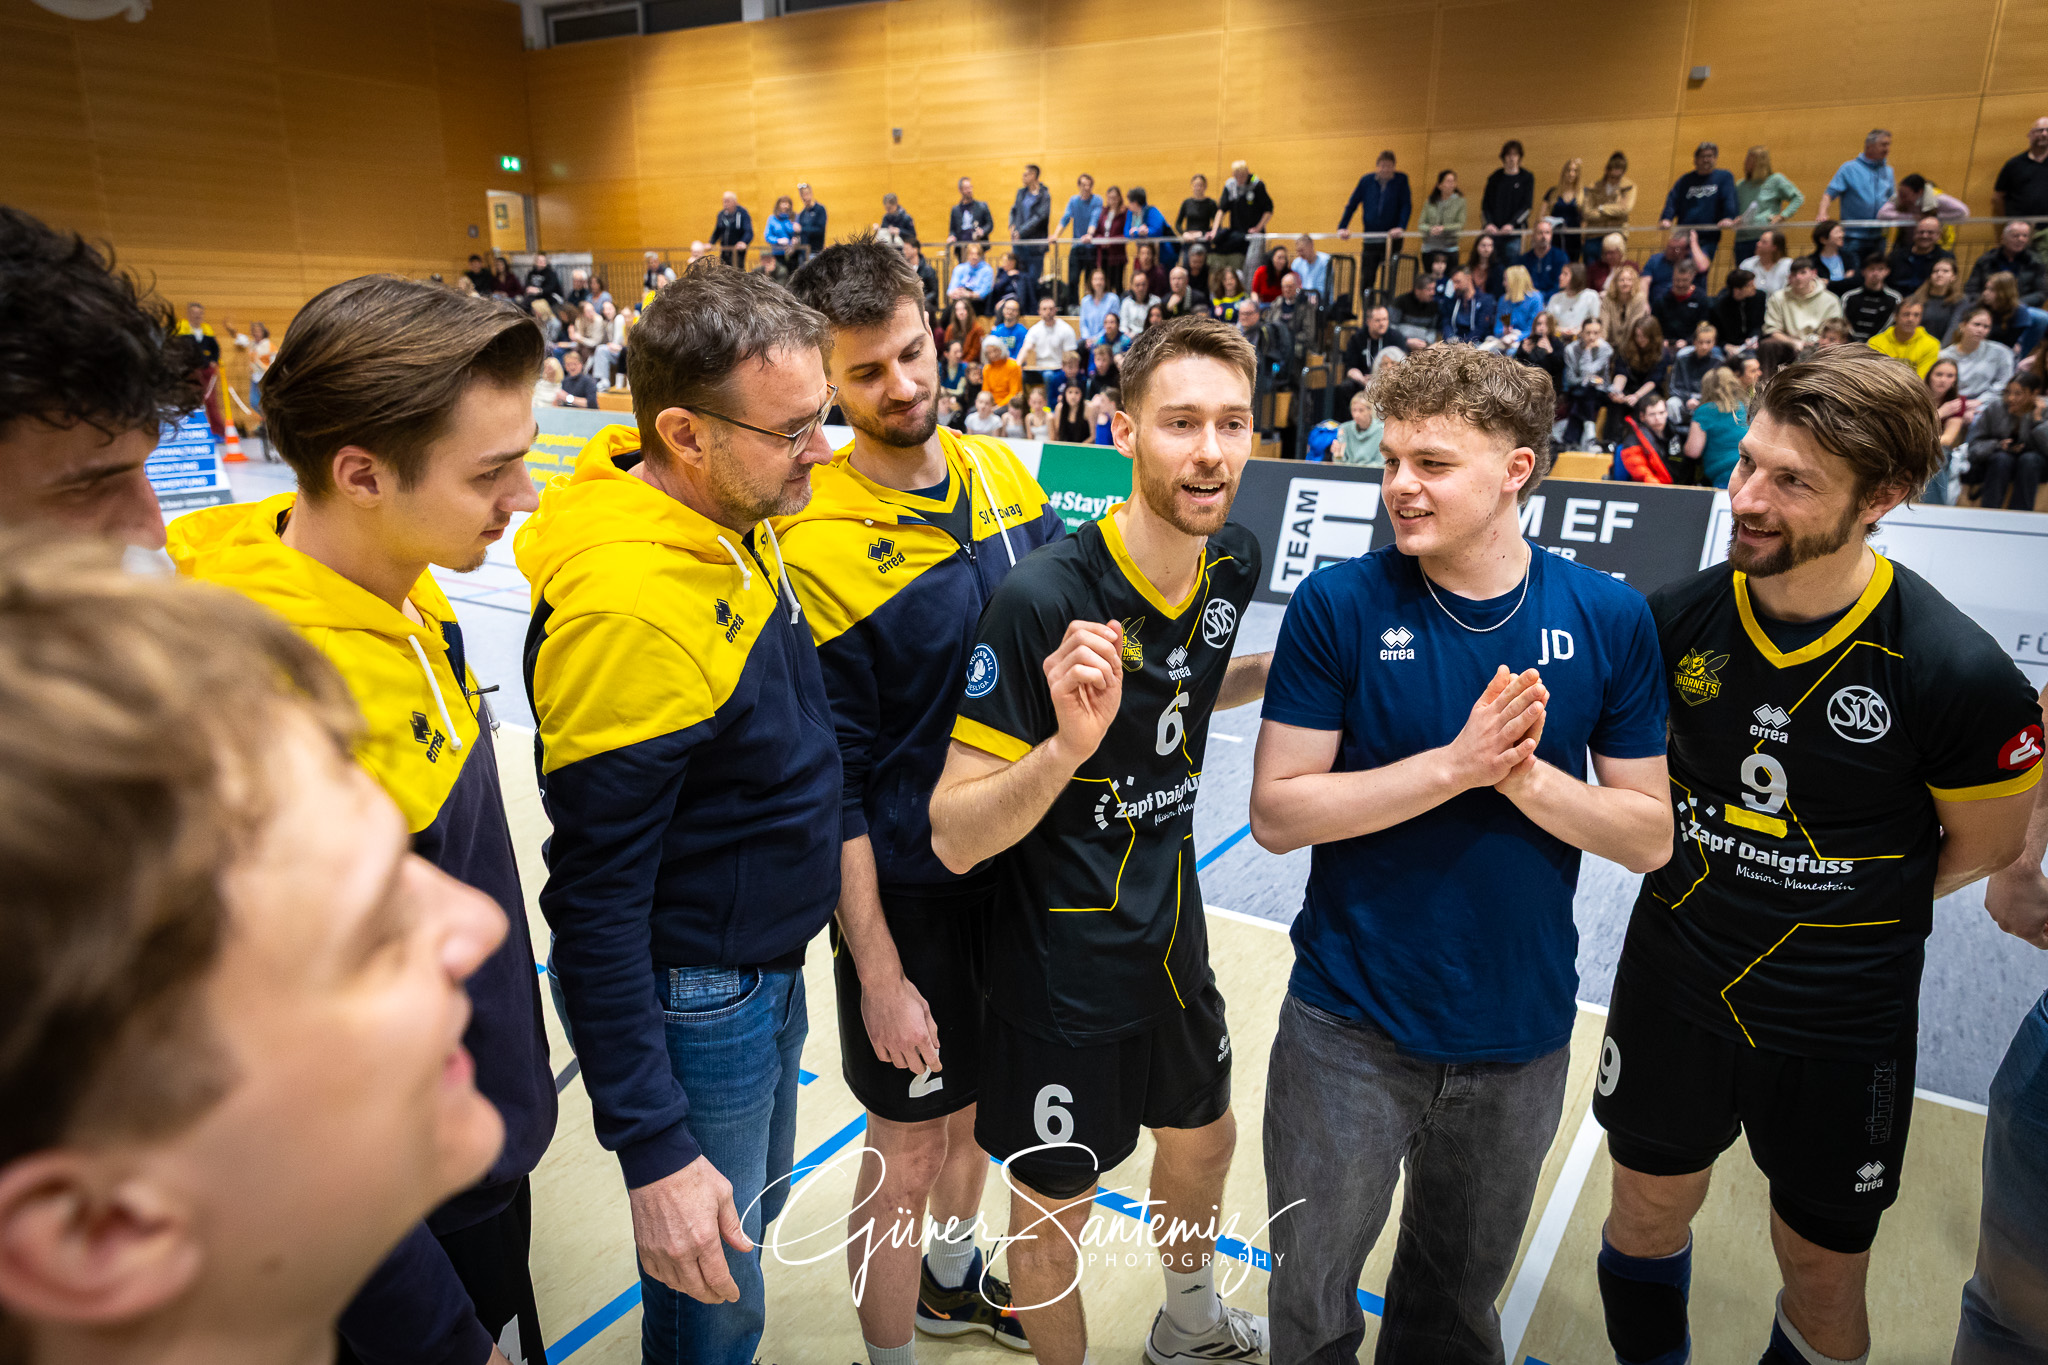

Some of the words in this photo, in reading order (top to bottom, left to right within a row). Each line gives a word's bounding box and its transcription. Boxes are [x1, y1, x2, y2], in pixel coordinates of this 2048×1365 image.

[1281, 490, 1319, 581] TEAM
[1560, 497, 1639, 544] EF
[878, 551, 906, 574] errea
[725, 613, 745, 643] errea
[1379, 648, 1415, 661] errea
[1537, 628, 1575, 665] JD
[1168, 665, 1192, 681] errea
[1676, 674, 1718, 695] HORNETS
[1155, 691, 1190, 756] 6
[1749, 724, 1789, 744] errea
[426, 729, 446, 764] errea
[1740, 753, 1788, 814] 9
[1114, 792, 1154, 819] Zapf
[1687, 819, 1735, 854] Zapf
[1738, 842, 1854, 875] Daigfuss
[1597, 1035, 1622, 1097] 9
[1033, 1083, 1075, 1145] 6
[1854, 1178, 1884, 1193] errea
